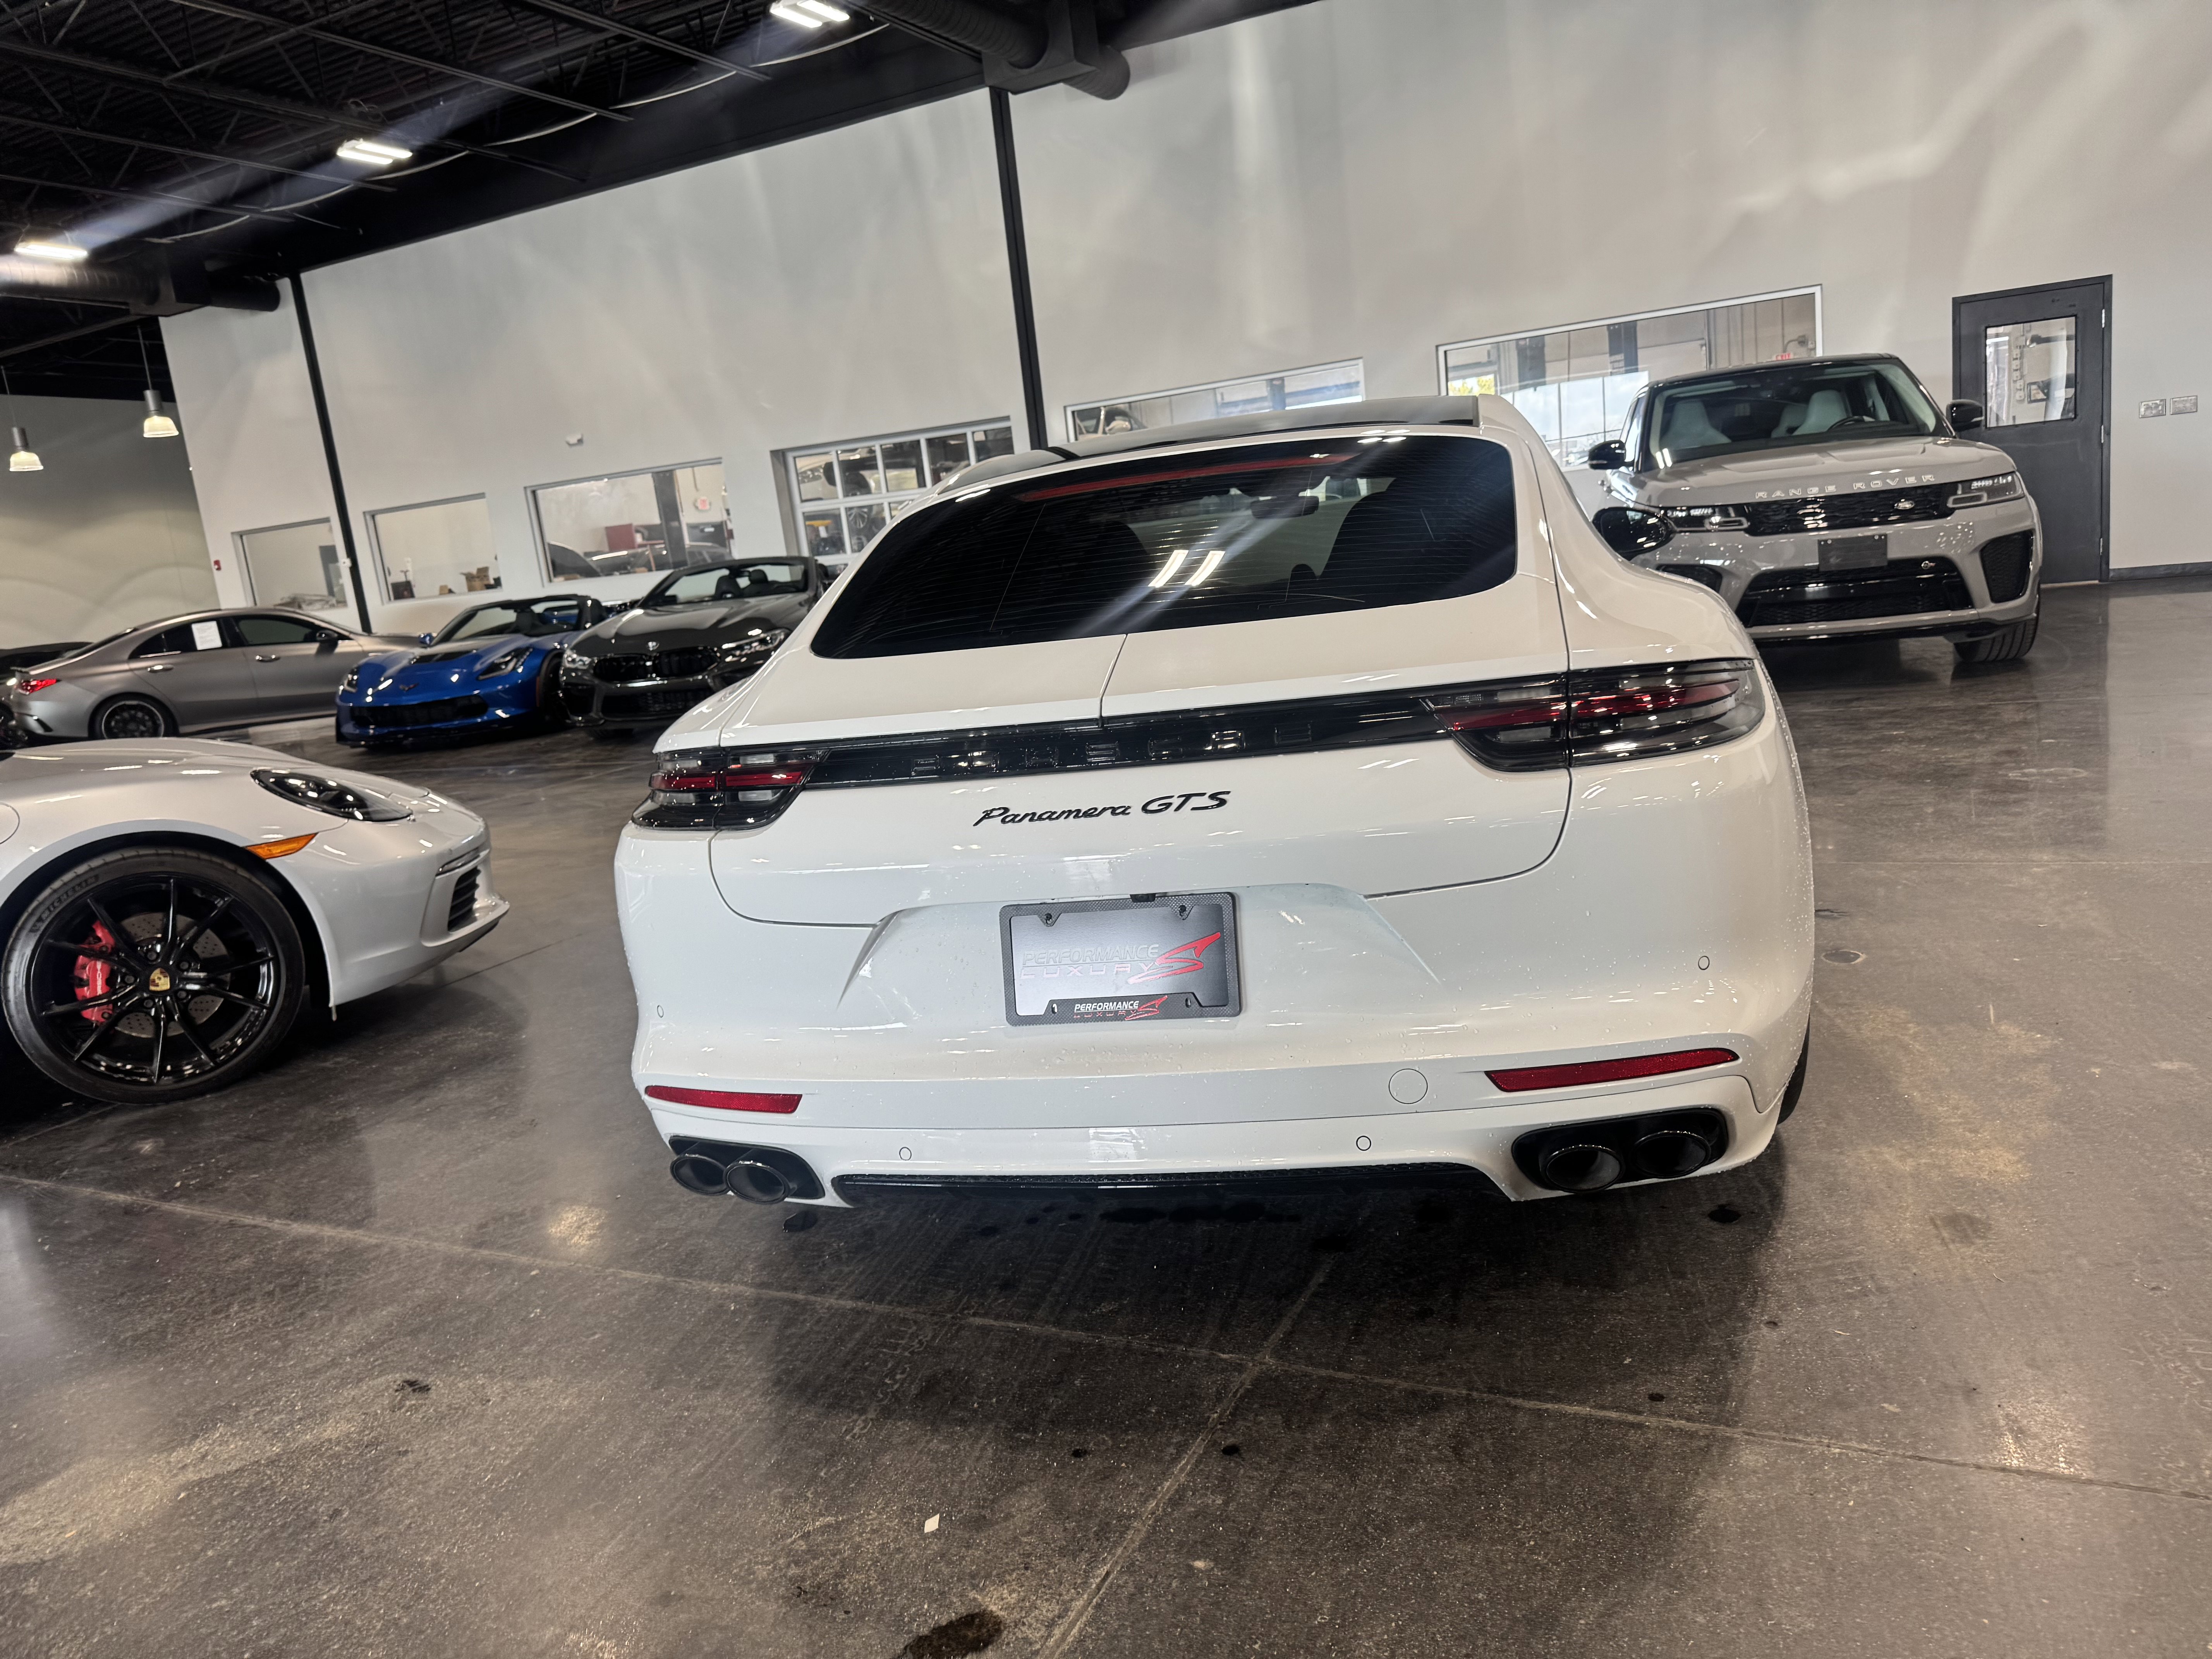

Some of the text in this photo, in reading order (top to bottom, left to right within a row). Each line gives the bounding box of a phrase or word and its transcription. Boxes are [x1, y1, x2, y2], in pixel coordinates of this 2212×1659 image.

[1755, 474, 1935, 499] RANGE ROVER
[973, 790, 1231, 826] Panamera GTS
[1022, 944, 1159, 966] PERFORMANCE
[1020, 962, 1156, 979] LUXURY
[1073, 1010, 1137, 1018] LUXURY
[1074, 1000, 1140, 1012] PERFORMANCE
